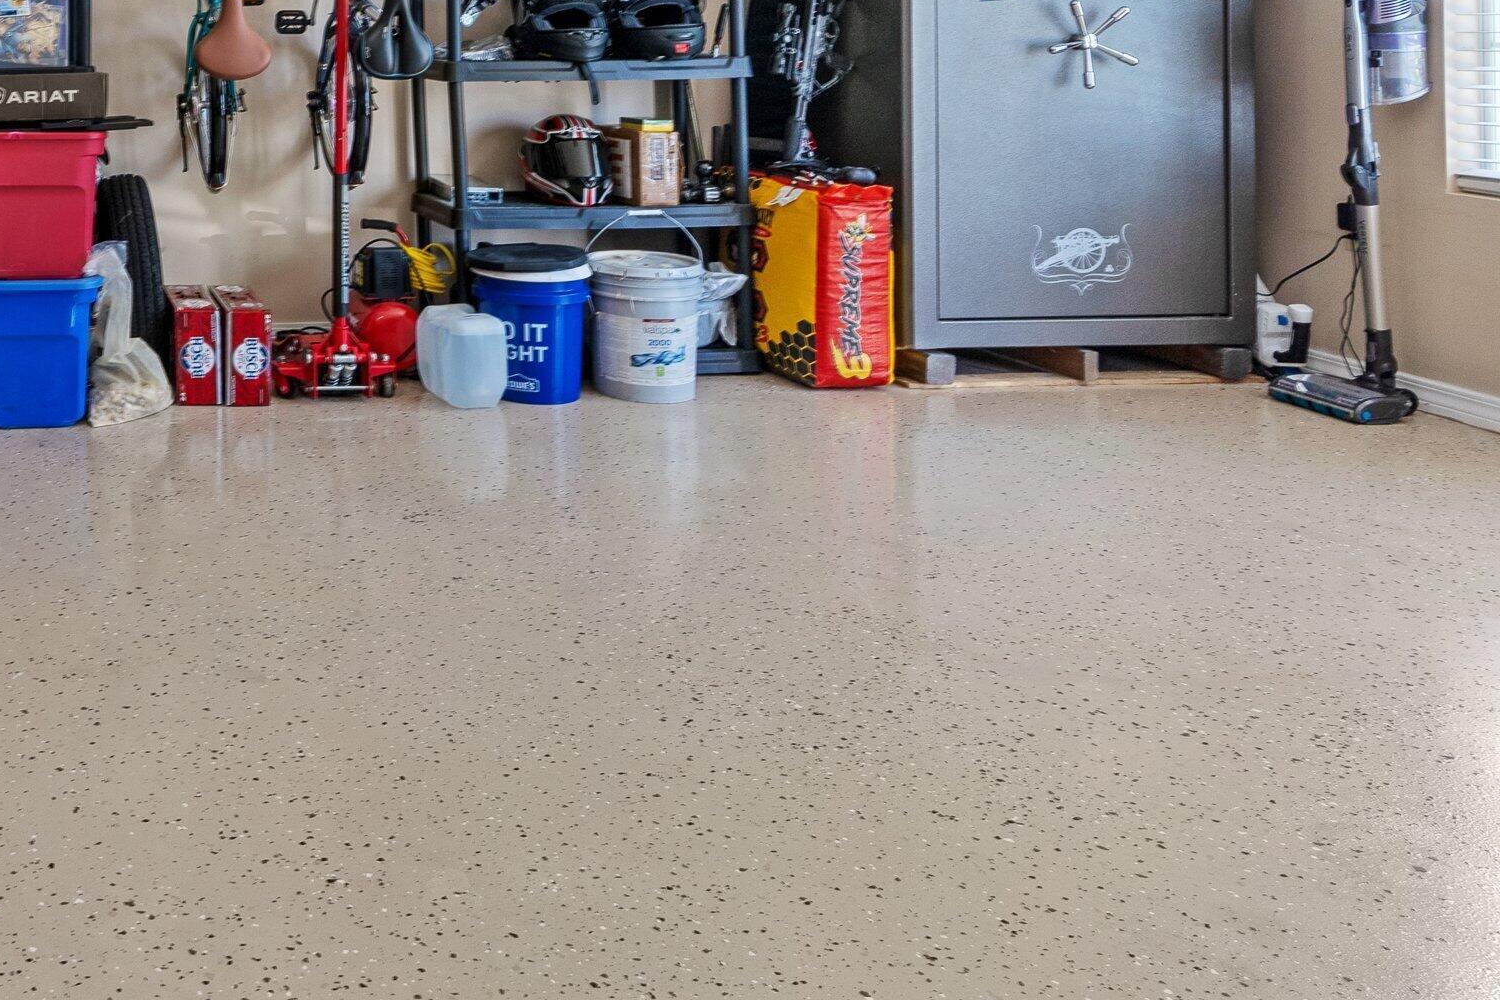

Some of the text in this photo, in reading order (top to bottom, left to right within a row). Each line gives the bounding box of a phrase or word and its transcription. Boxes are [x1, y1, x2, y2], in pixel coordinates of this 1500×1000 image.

[5, 89, 80, 105] ARIAT
[838, 230, 863, 356] SUPREME
[523, 323, 548, 342] IT
[190, 338, 204, 377] BUSCH
[244, 338, 259, 378] BUSCH
[506, 344, 549, 363] GHT
